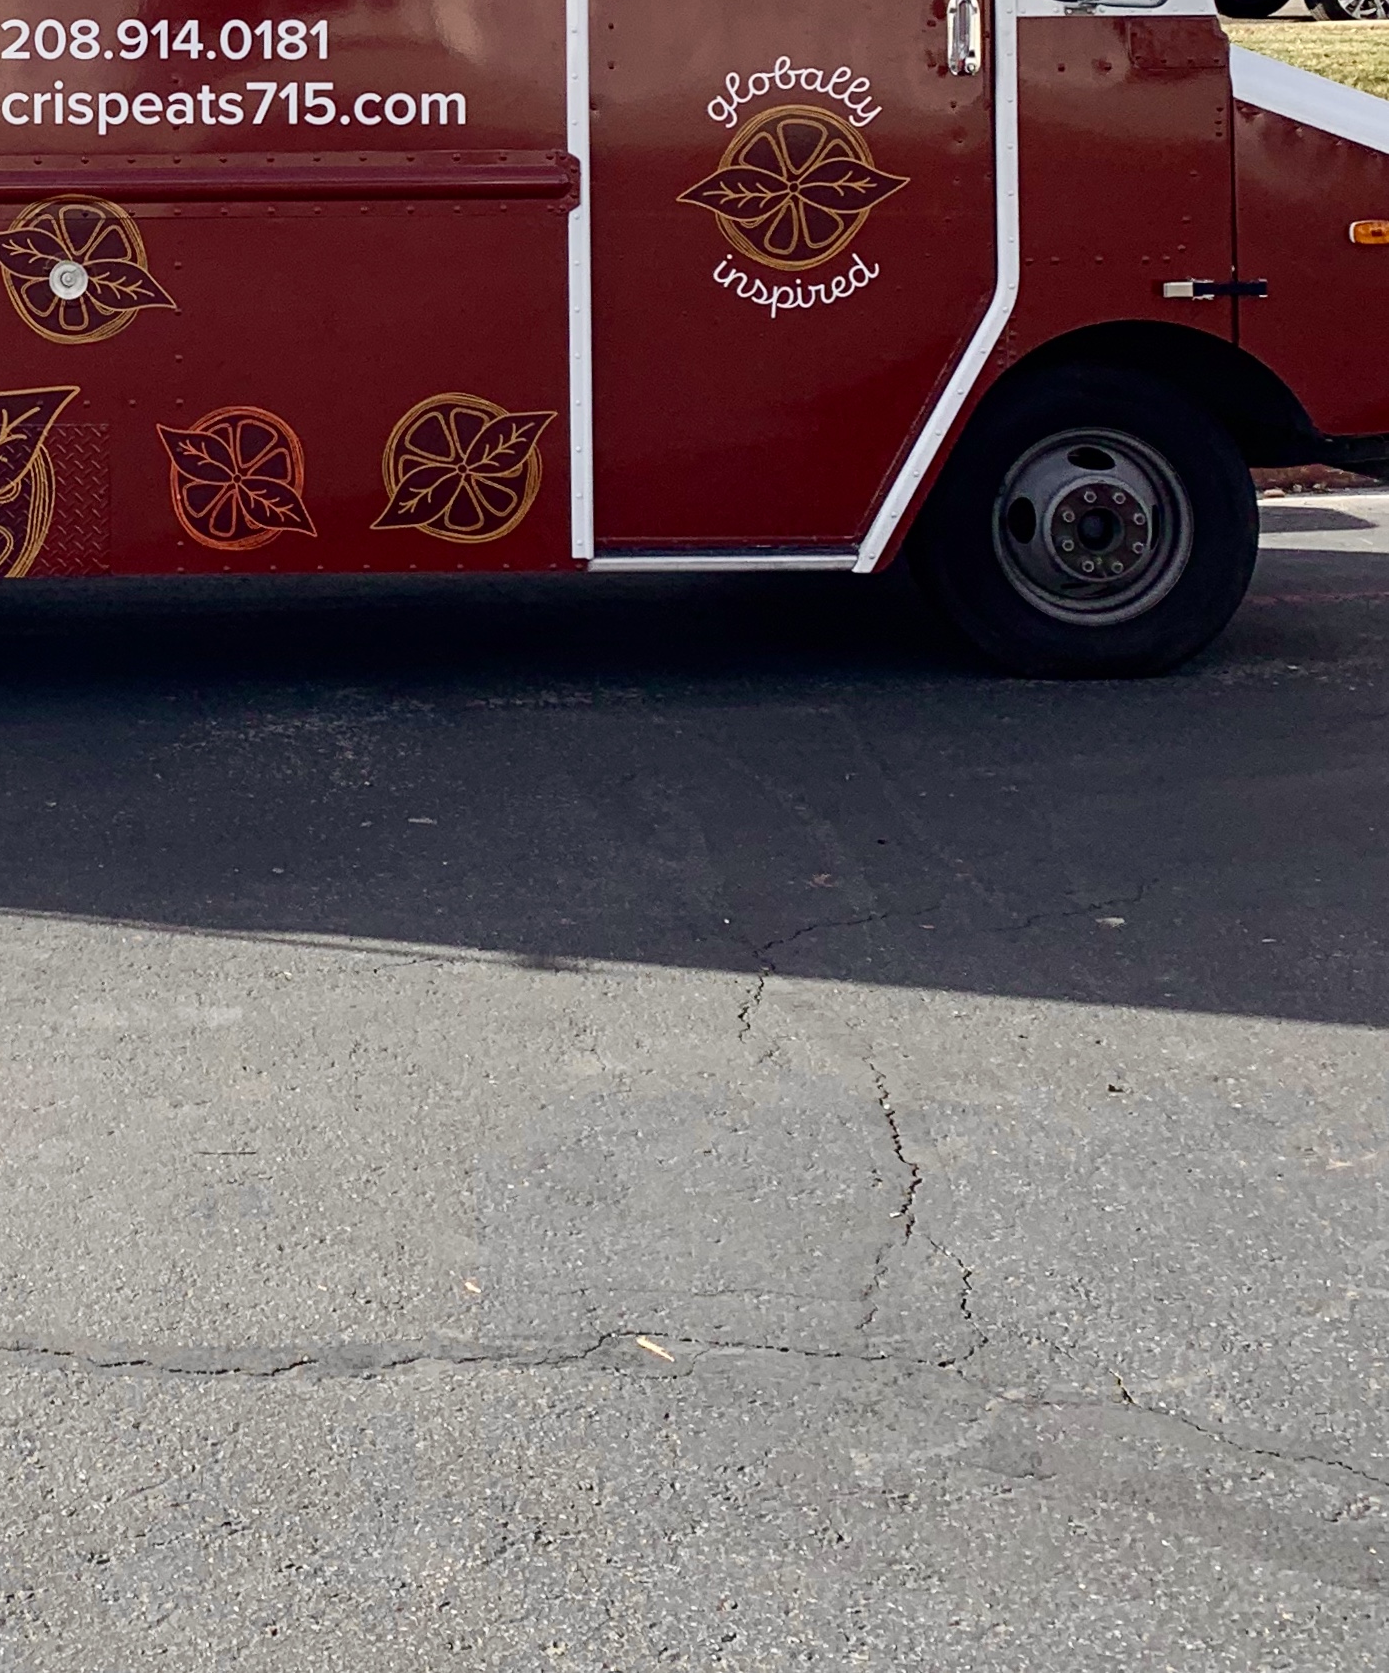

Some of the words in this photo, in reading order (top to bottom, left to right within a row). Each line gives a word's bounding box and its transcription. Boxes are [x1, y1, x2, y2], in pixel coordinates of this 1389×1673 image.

[0, 19, 330, 61] 208.914.0181
[1, 80, 467, 135] crispeats715.com
[707, 55, 883, 129] globally
[713, 253, 880, 319] inspired
